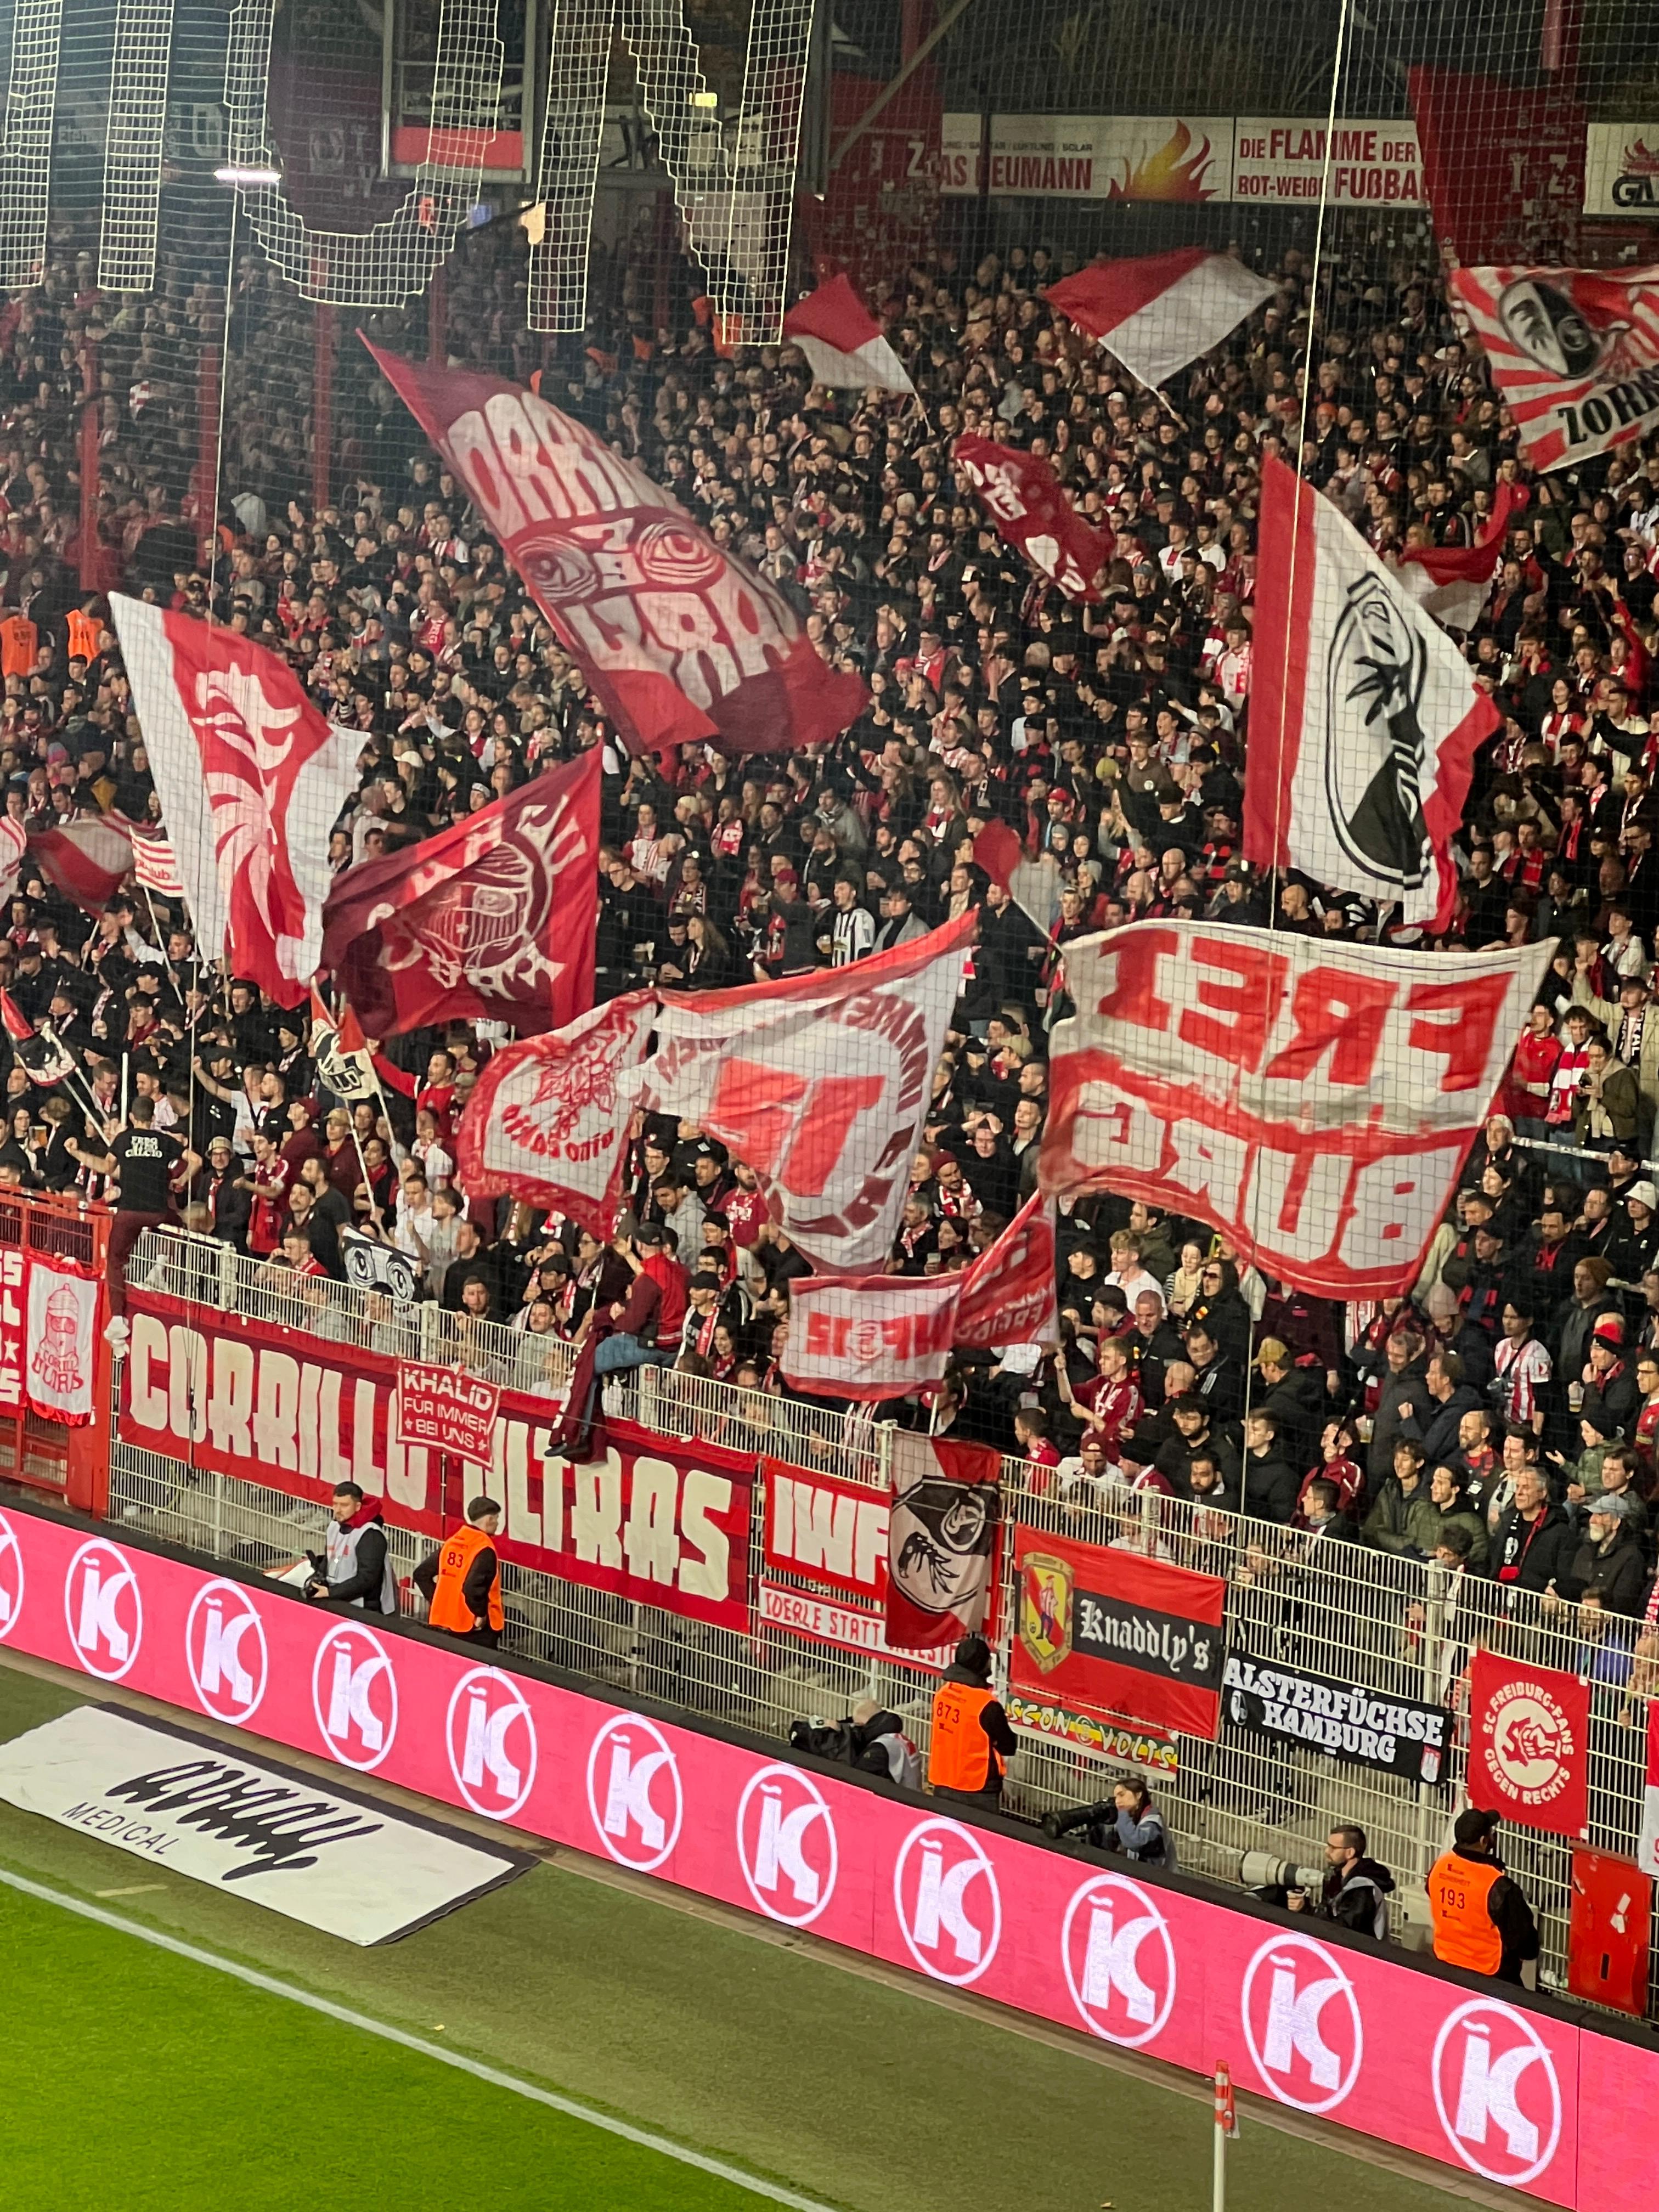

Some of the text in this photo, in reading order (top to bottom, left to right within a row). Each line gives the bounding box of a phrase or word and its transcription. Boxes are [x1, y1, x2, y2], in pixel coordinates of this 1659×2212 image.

[1240, 129, 1415, 162] DIE FLAMME DER
[404, 1368, 492, 1411] KHALID
[415, 1419, 475, 1448] BEI UNS
[437, 1403, 487, 1435] IMMER
[462, 1417, 733, 1602] ULTRAS
[447, 1551, 464, 1568] 83
[830, 1612, 881, 1646] STATT
[1079, 1598, 1211, 1673] Knaddly's
[936, 1702, 961, 1724] 873
[1223, 1657, 1445, 1747] ALSTERFÜCHSE
[1482, 1681, 1575, 1756] SC FREIBURG-FANS
[1262, 1700, 1397, 1764] HAMBURG
[1522, 1767, 1571, 1805] RECHTS
[61, 1801, 179, 1855] MEDICAL
[1440, 1887, 1465, 1909] 193
